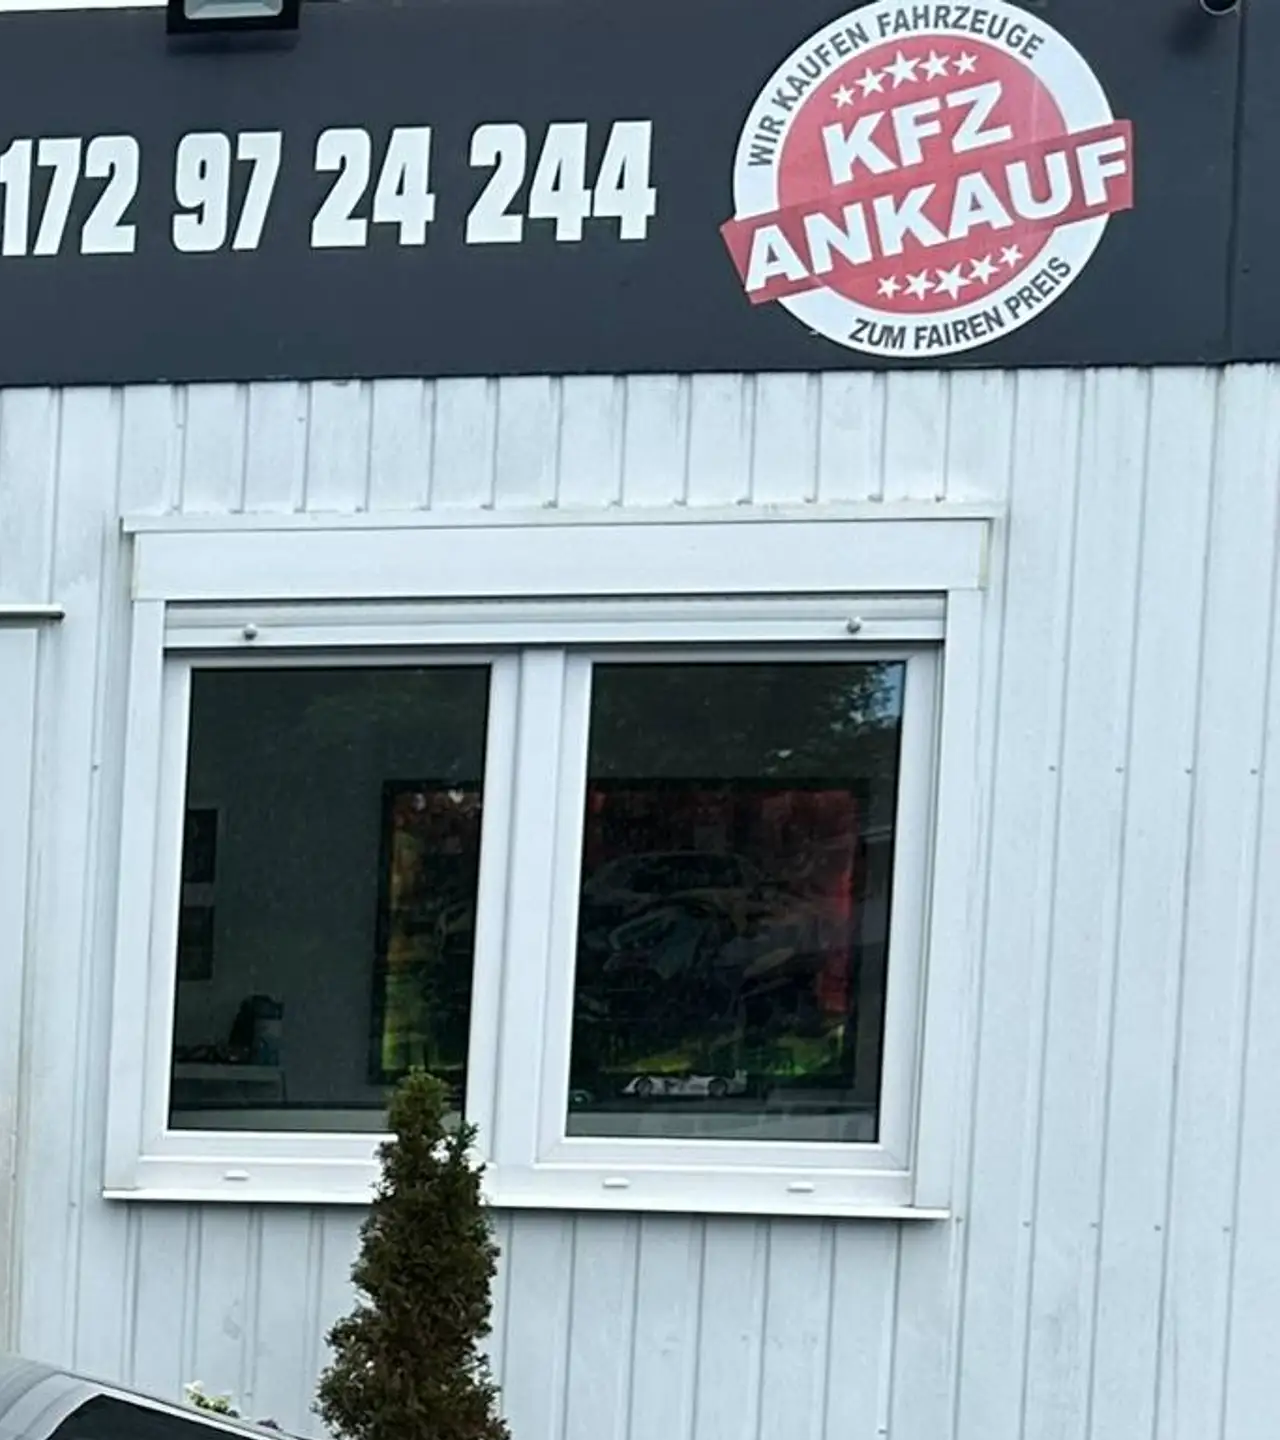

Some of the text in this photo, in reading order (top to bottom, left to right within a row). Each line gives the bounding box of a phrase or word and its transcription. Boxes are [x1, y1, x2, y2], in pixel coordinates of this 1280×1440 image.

[747, 4, 1044, 167] WIR KAUFEN FAHRZEUGE
[821, 80, 1012, 185] KFZ
[171, 130, 283, 253] 97
[310, 125, 436, 249] 24
[465, 119, 658, 245] 244
[745, 137, 1127, 293] ANKAUF
[849, 256, 1071, 351] ZUM FAIREN PREIS
